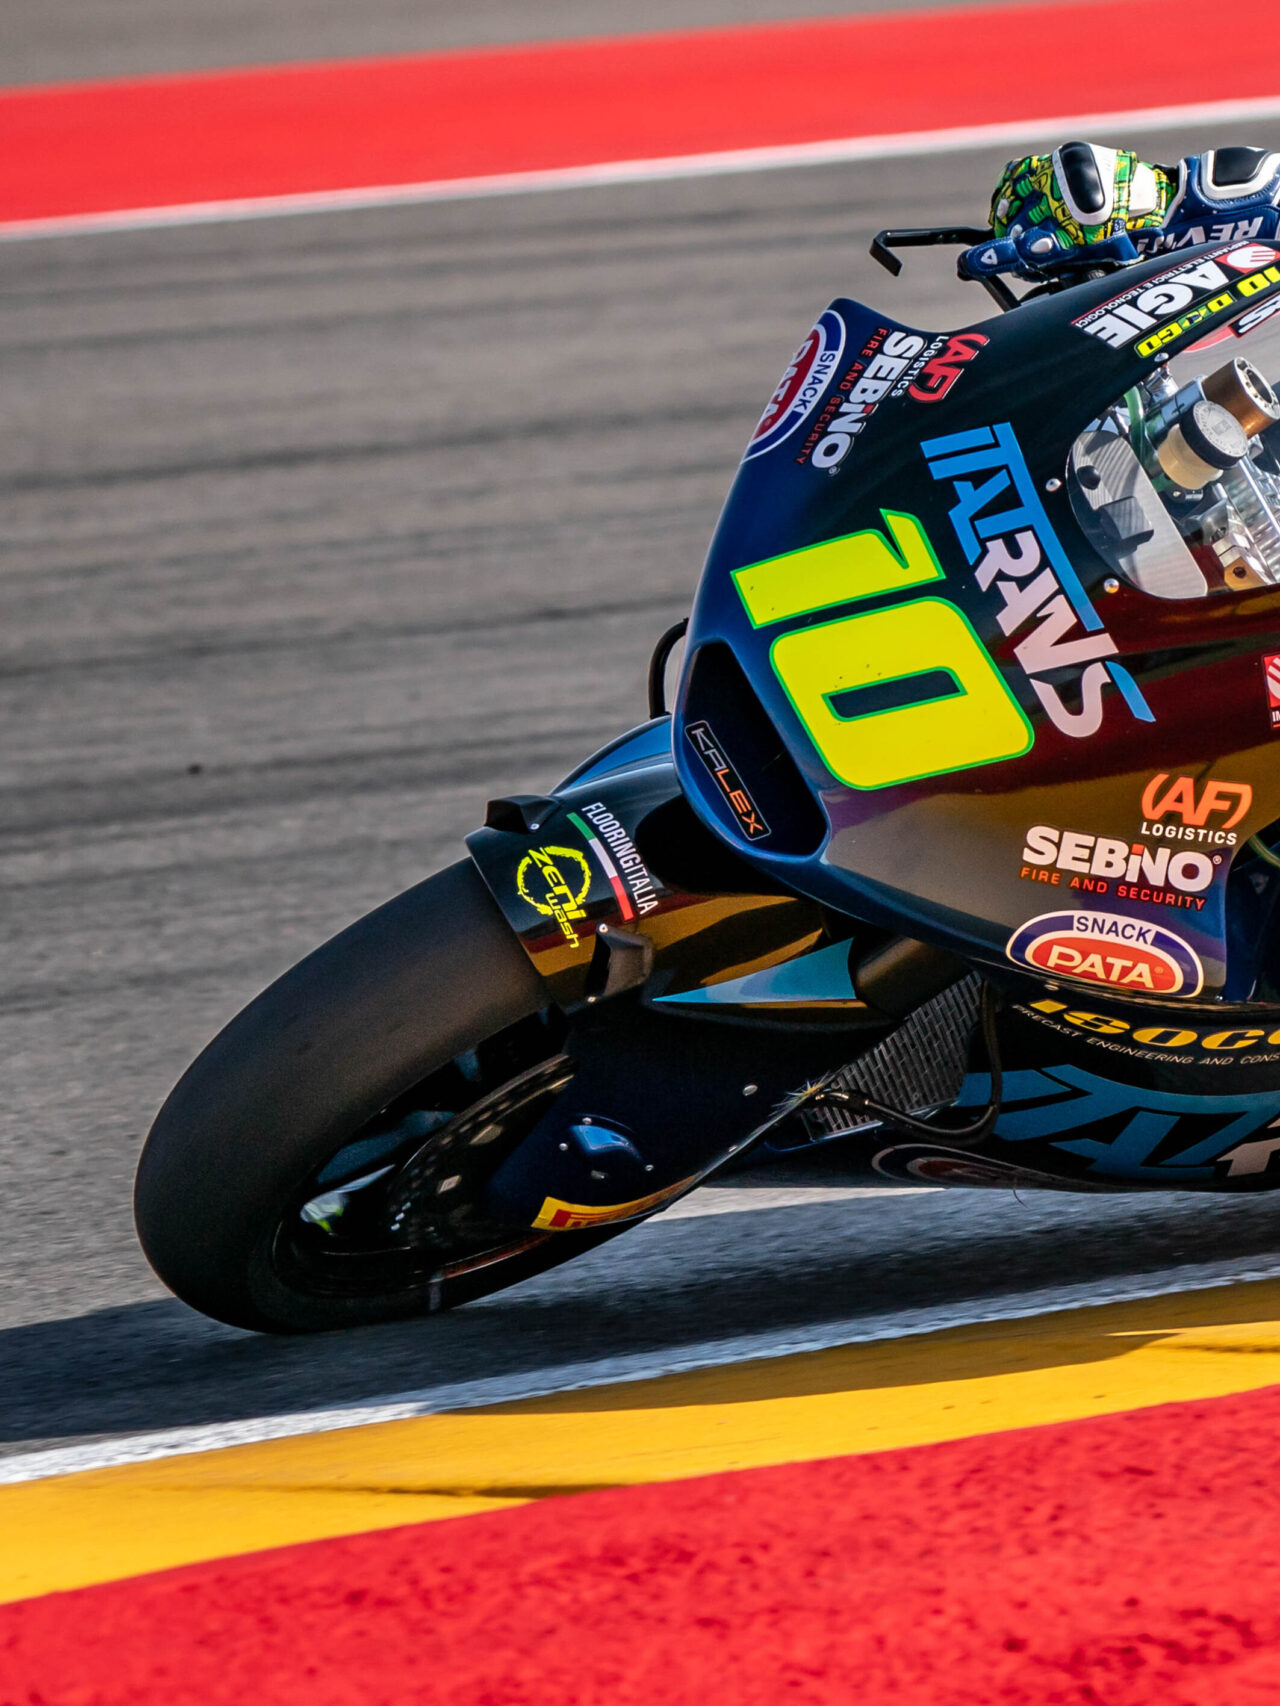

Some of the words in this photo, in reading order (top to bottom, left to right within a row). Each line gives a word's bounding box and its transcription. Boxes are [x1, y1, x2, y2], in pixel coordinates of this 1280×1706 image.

[1075, 286, 1148, 327] TECNOLOGICI
[1083, 260, 1229, 349] AGIE
[858, 327, 889, 358] FIRE
[891, 335, 950, 398] LOGISTICS
[794, 352, 835, 411] SNACK
[839, 362, 864, 392] AND
[795, 397, 842, 465] SECURITY
[730, 508, 1035, 791] 10
[691, 727, 763, 835] KALEX
[581, 801, 659, 915] FLOORINGITALIA
[1141, 822, 1238, 846] LOGISTICS
[1020, 867, 1060, 885] FIRE
[1070, 875, 1108, 894] AND
[1117, 885, 1206, 911] SECURITY
[1076, 916, 1152, 944] SNACK
[1046, 945, 1156, 989] PATA
[1012, 1004, 1083, 1037] PRECAST
[1086, 1037, 1194, 1064] ENGINEERING
[1198, 1056, 1233, 1065] AND
